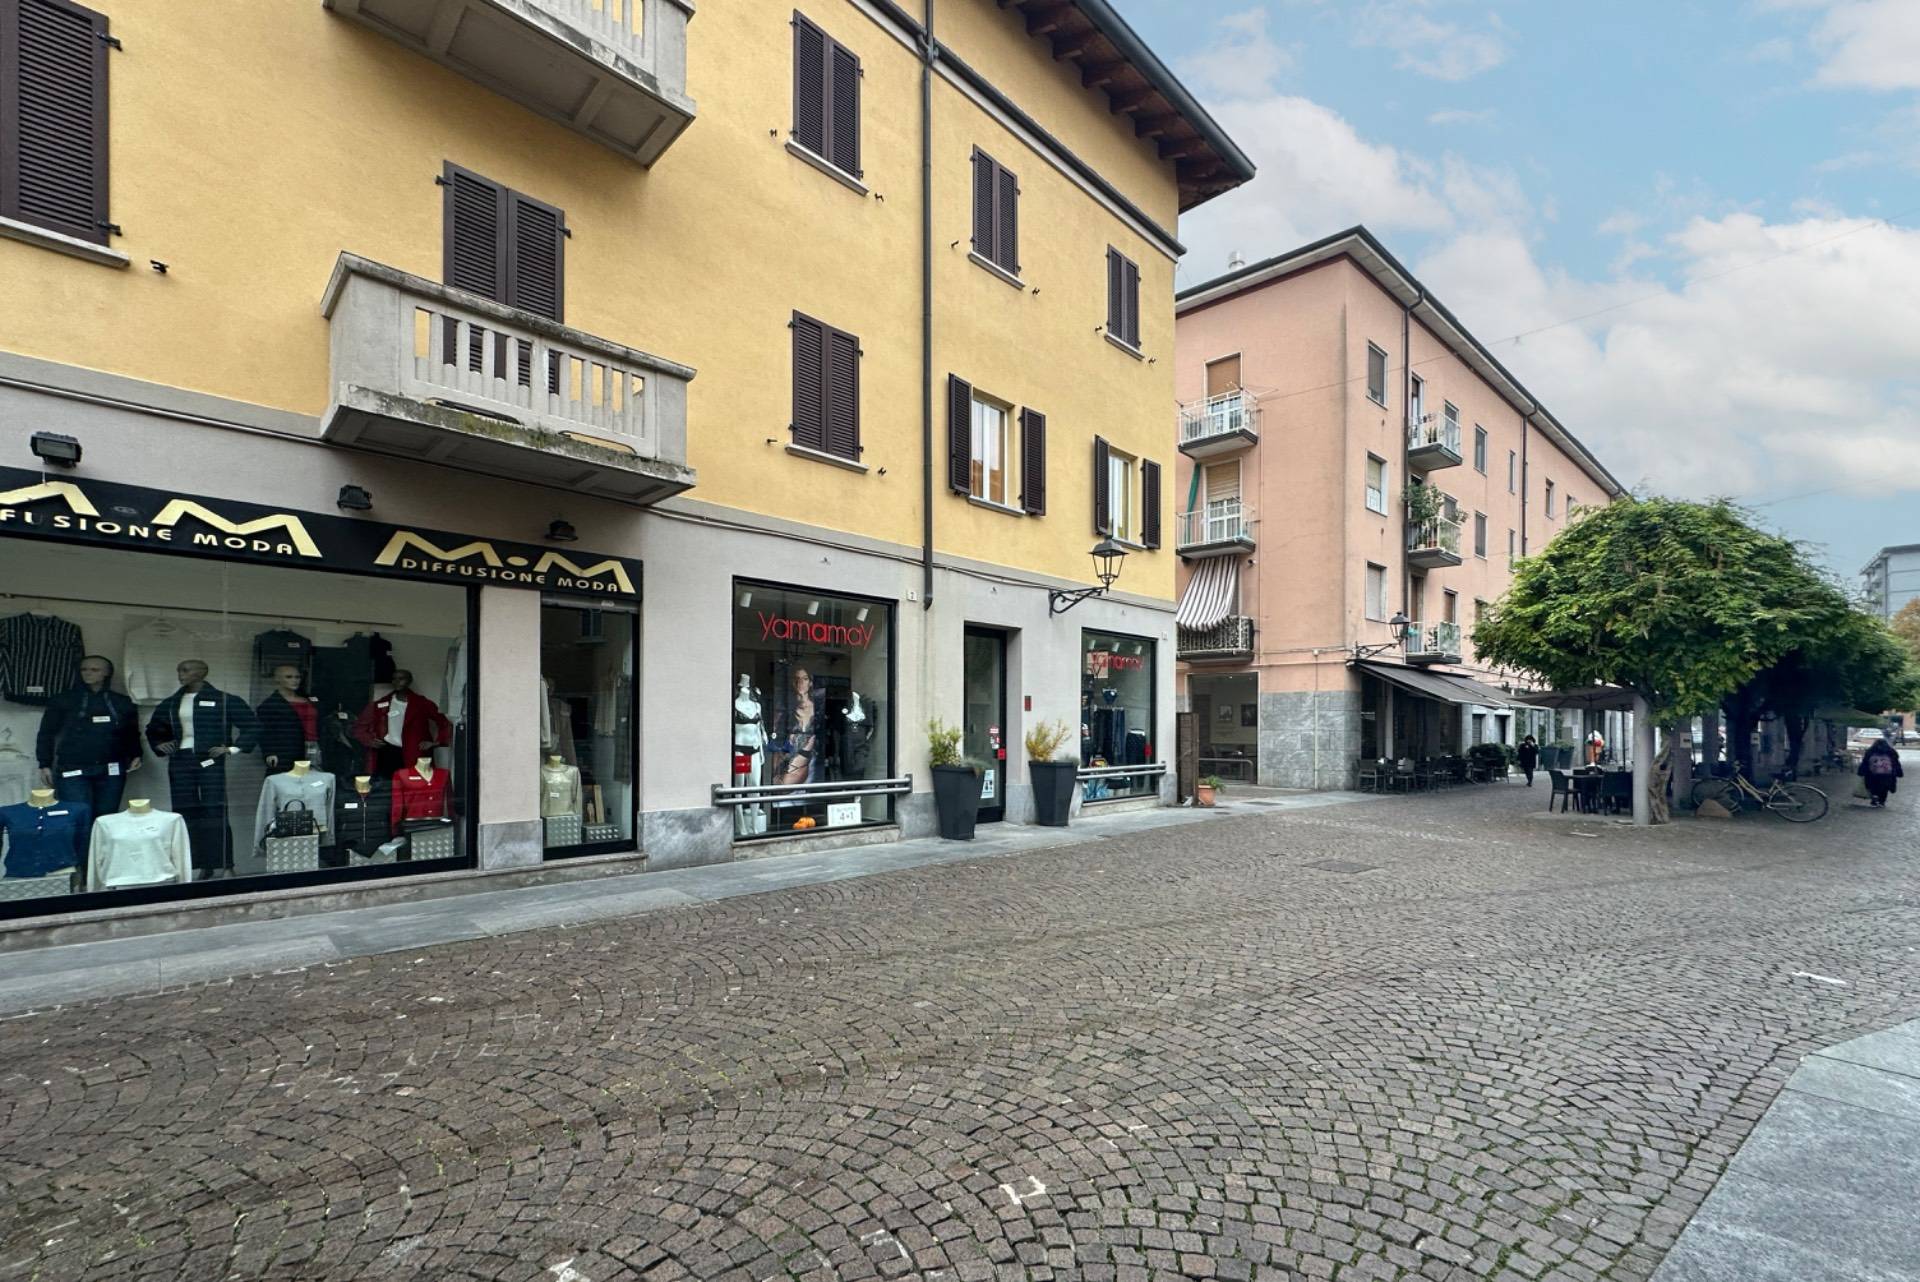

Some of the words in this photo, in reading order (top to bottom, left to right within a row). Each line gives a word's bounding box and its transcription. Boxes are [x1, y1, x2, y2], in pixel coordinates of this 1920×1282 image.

[193, 533, 293, 555] MODA
[402, 558, 545, 584] DIFFUSIONE
[557, 578, 618, 592] MODA
[758, 611, 875, 650] yamamay
